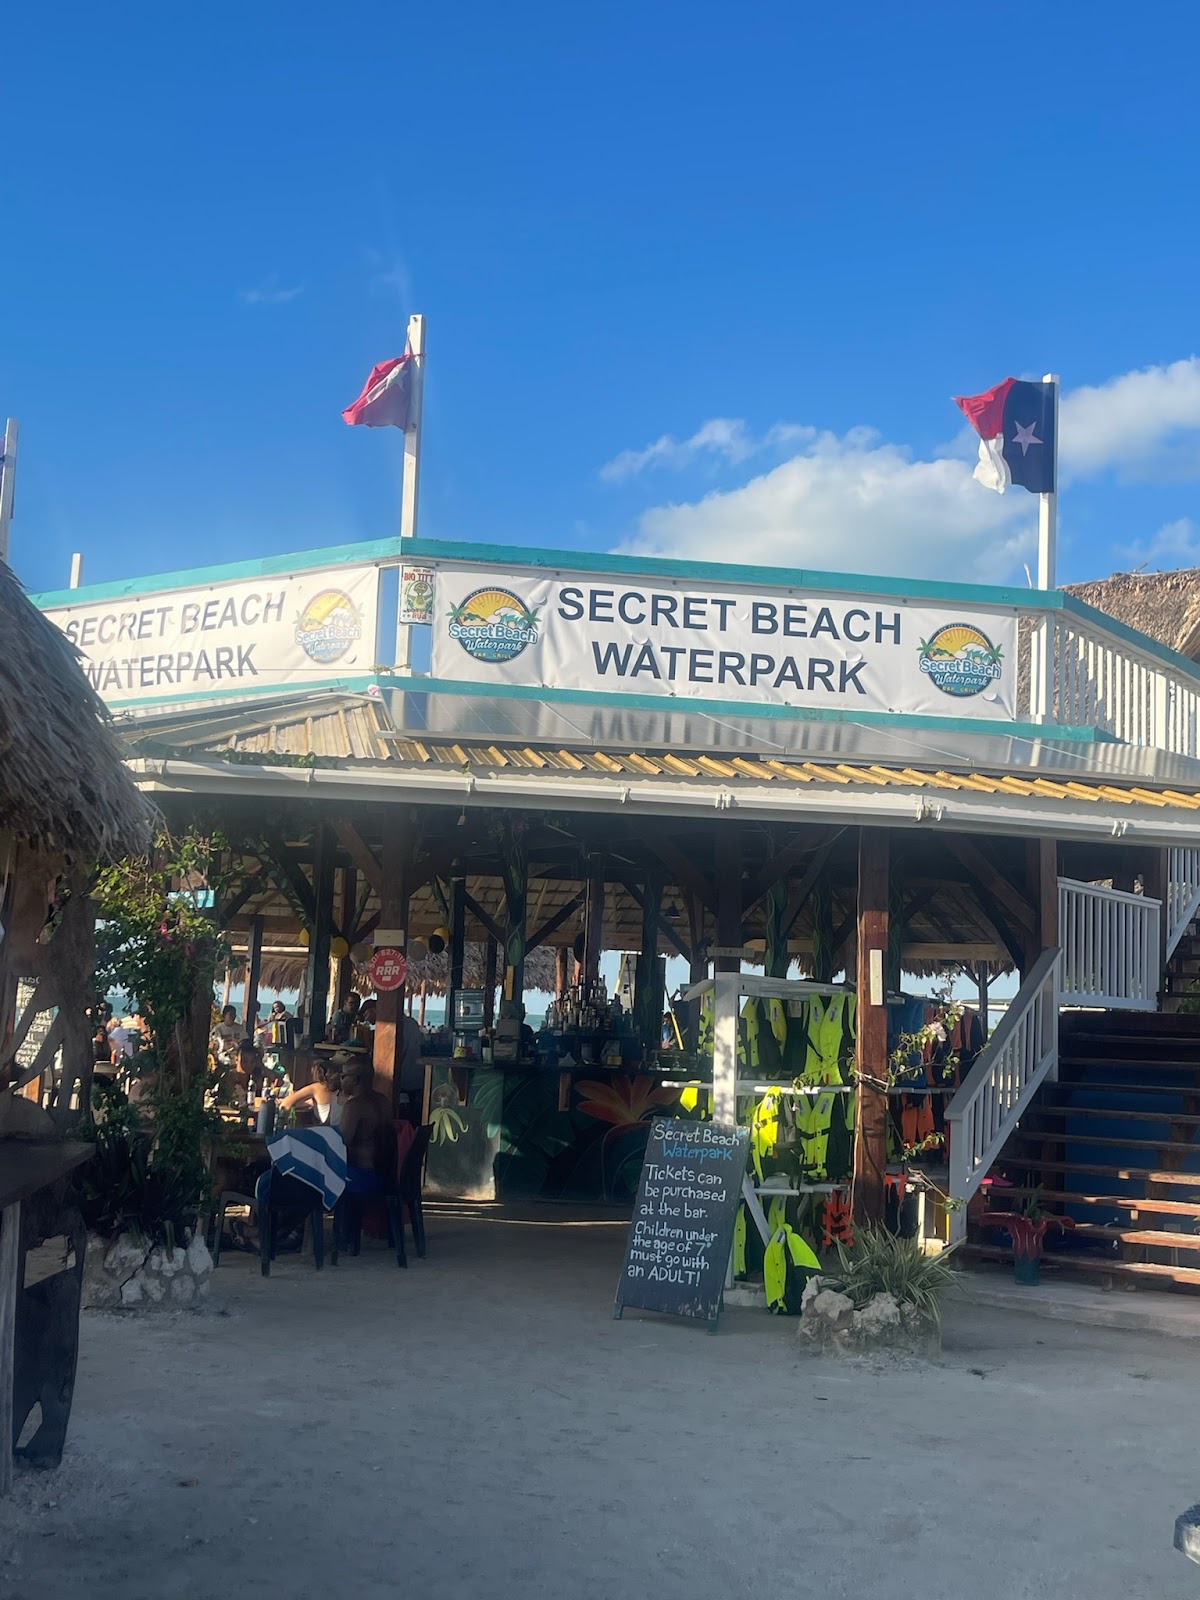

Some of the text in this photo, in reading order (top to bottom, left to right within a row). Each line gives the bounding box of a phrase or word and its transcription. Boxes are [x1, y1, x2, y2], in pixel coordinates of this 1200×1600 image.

[66, 591, 287, 647] SECRET BEACH
[557, 587, 902, 645] SECRET BEACH
[296, 625, 361, 644] Secret Beach
[450, 624, 537, 643] Secret Beach
[465, 638, 523, 651] Waterpark
[85, 643, 259, 691] WATERPARK
[592, 640, 868, 695] WATERPARK
[920, 659, 1001, 678] Secret Beach
[934, 673, 988, 686] Waterpark
[653, 1123, 740, 1147] Secret Beach
[662, 1140, 733, 1163] Waterpark
[645, 1163, 722, 1185] Tickets can
[645, 1181, 726, 1204] be purchased
[640, 1202, 709, 1219] at the bar.
[635, 1221, 719, 1242] Children under
[632, 1236, 652, 1248] the
[653, 1239, 676, 1256] age
[677, 1240, 693, 1253] of
[630, 1249, 710, 1270] must go with
[627, 1265, 702, 1287] an ADULT!
